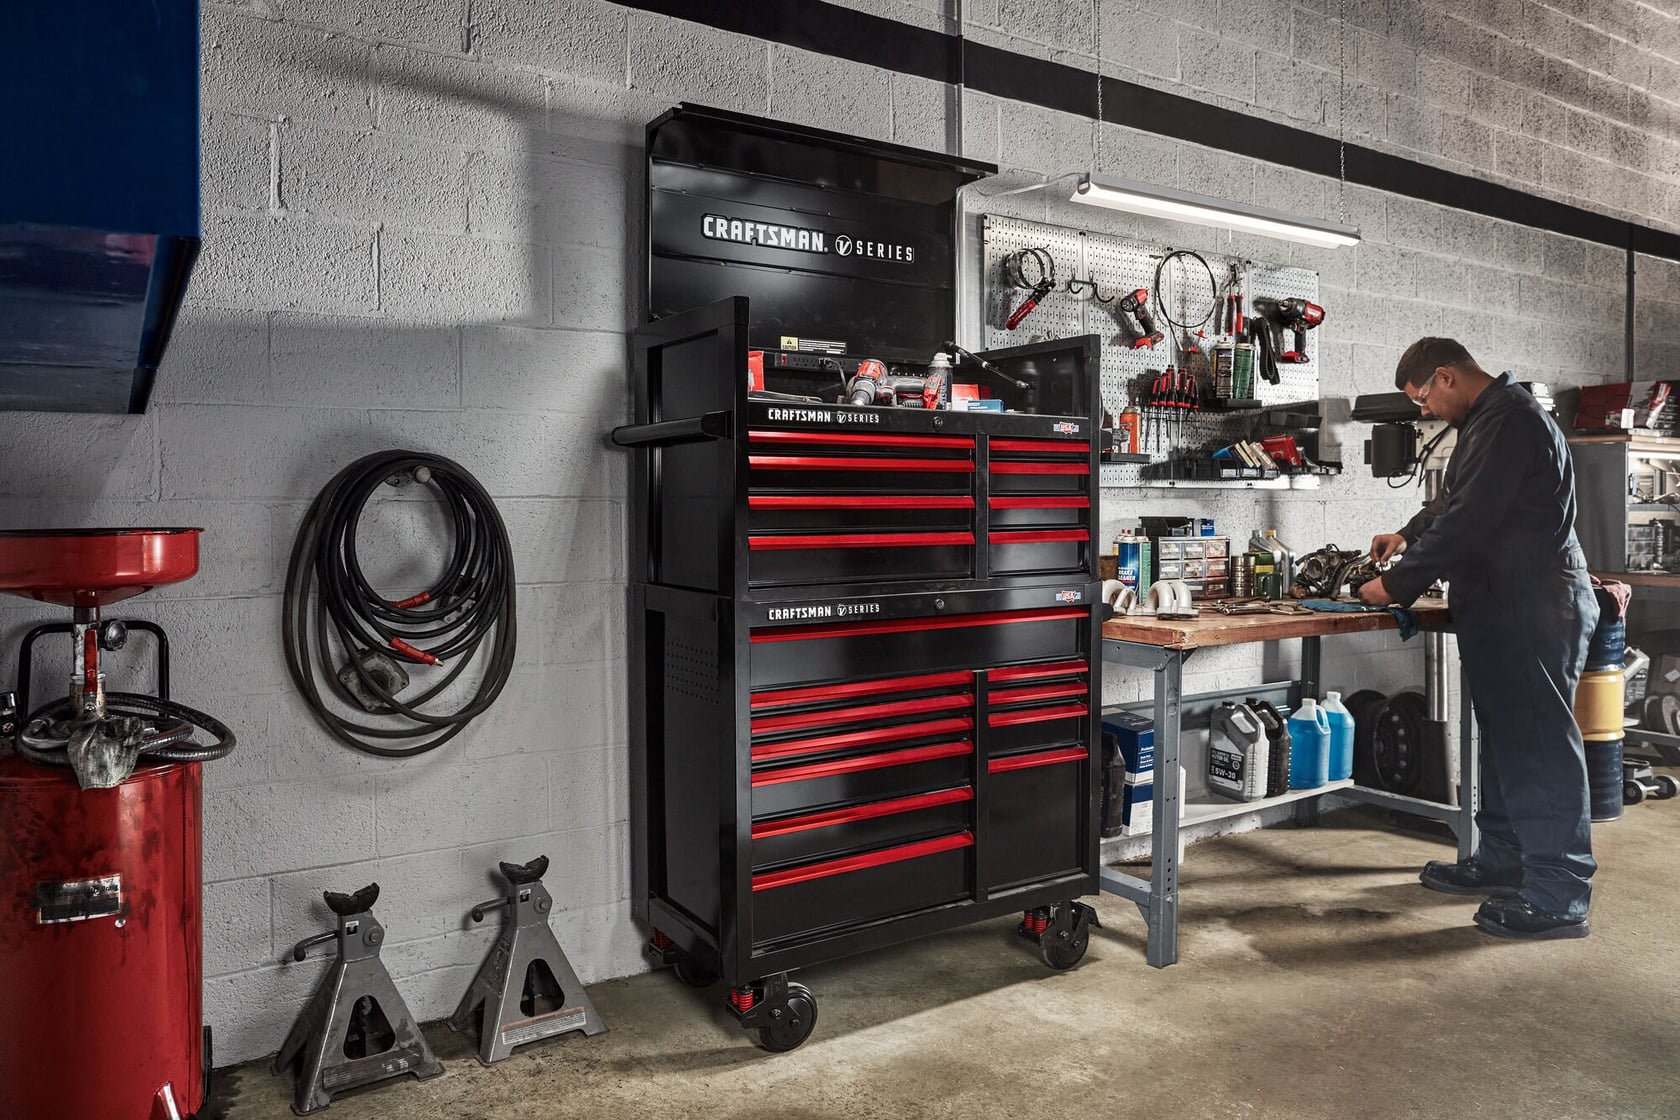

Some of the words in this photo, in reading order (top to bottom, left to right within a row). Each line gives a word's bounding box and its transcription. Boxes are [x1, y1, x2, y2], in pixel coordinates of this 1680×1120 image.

[703, 216, 824, 252] CRAFTSMAN
[856, 241, 913, 261] SERIES
[768, 408, 831, 423] CRAFTSMAN
[848, 413, 880, 424] SERIES
[768, 606, 831, 620] CRAFTSMAN
[848, 603, 880, 615] SERIES
[1215, 767, 1236, 780] 5W-30
